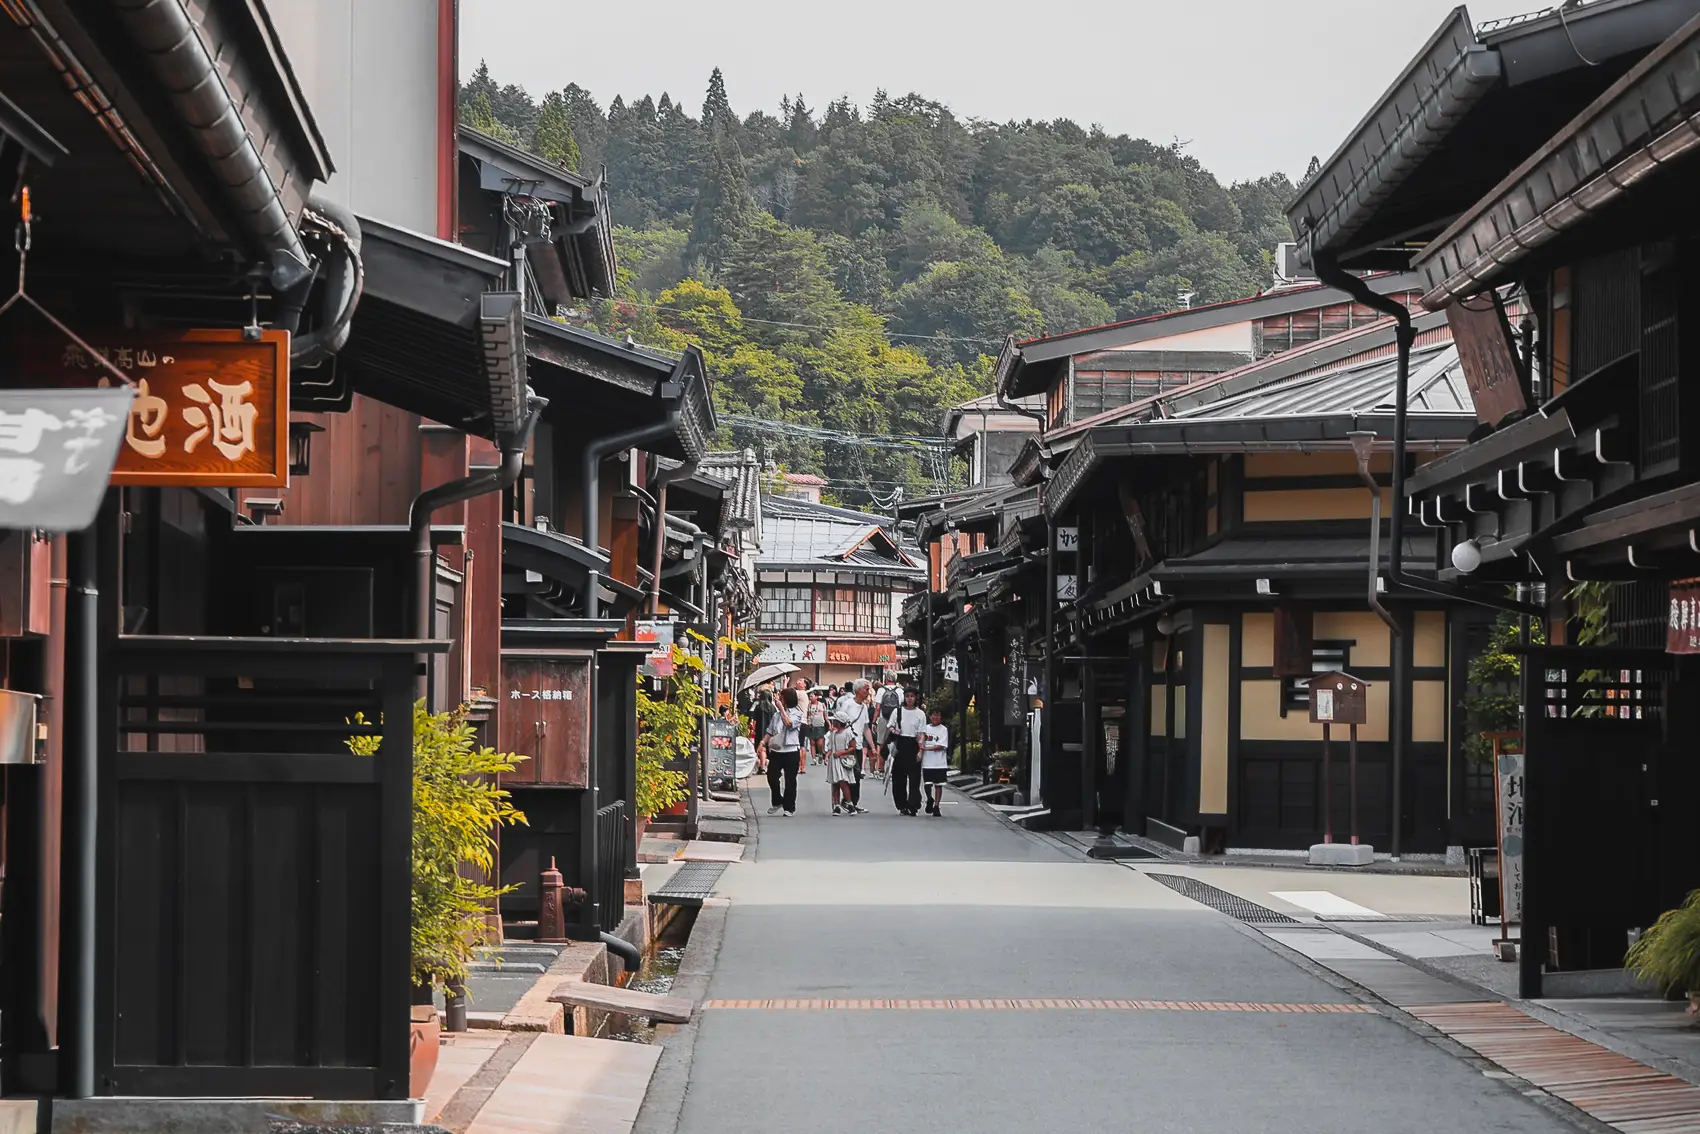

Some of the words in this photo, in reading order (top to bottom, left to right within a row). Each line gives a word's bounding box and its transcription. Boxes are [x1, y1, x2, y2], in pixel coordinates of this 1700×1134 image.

[510, 690, 573, 700] ホース格納箱
